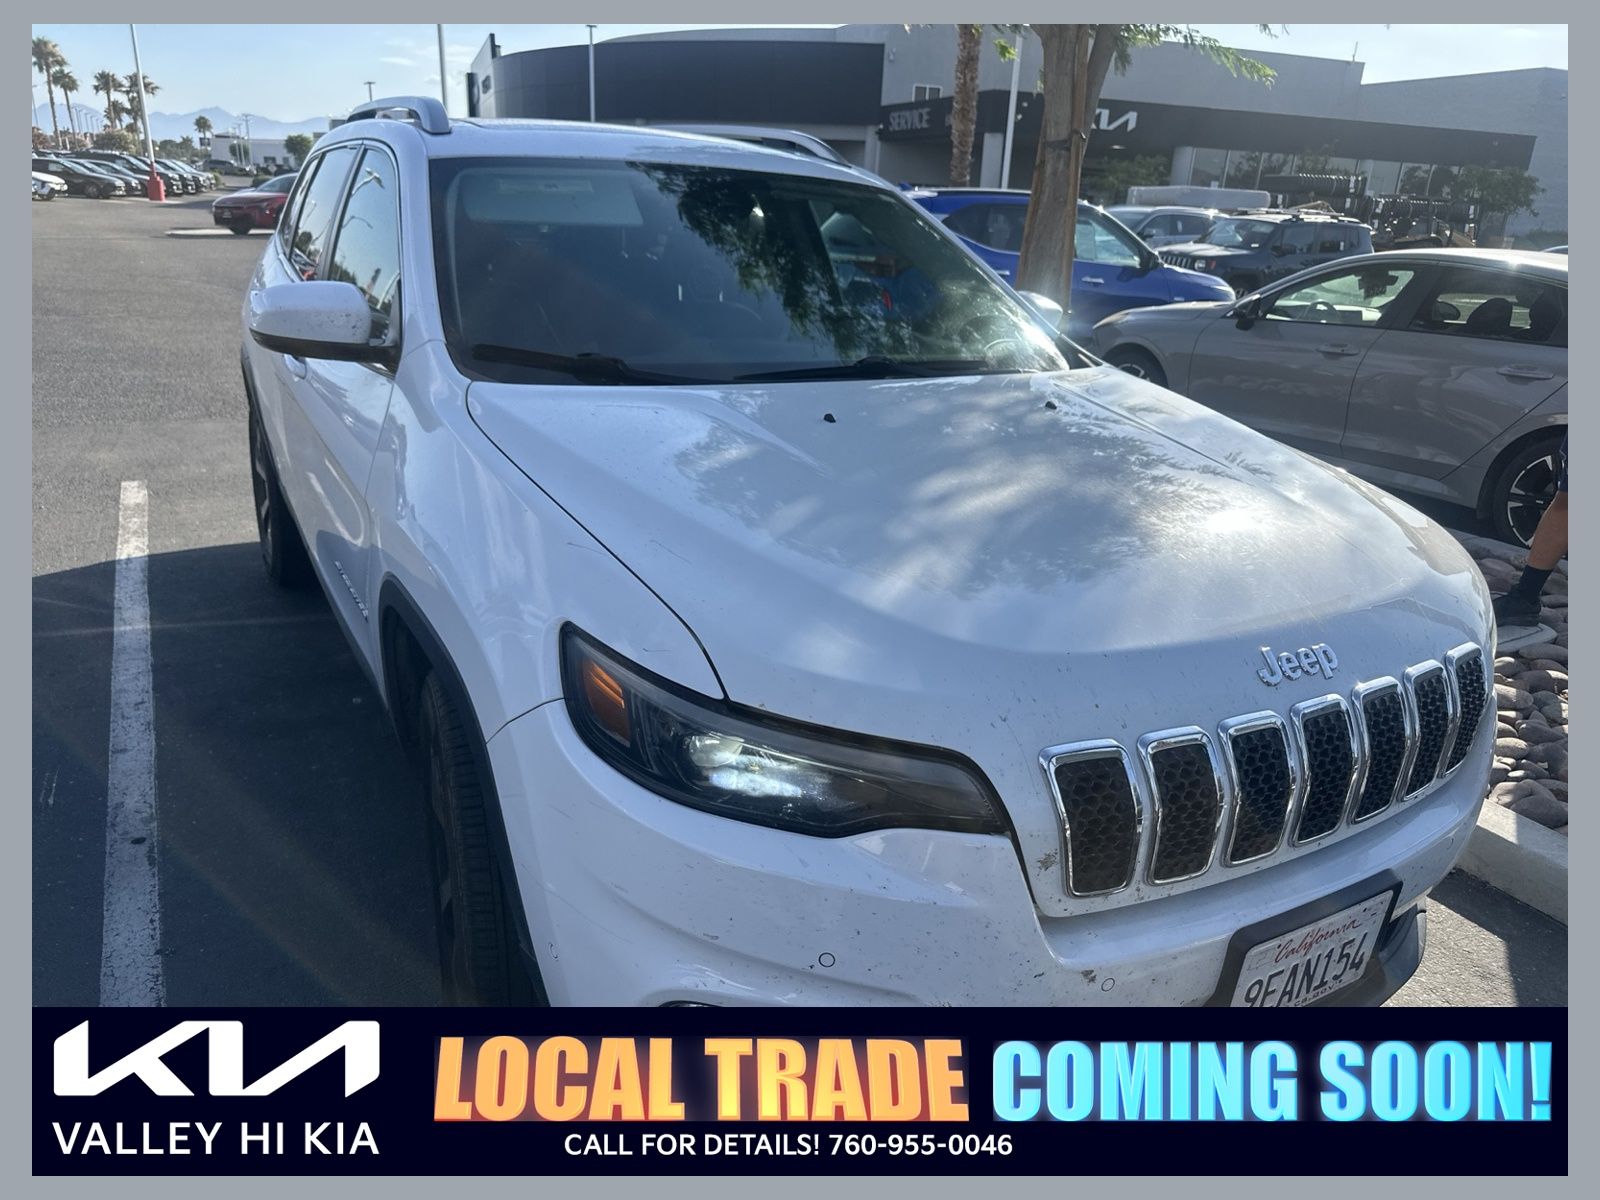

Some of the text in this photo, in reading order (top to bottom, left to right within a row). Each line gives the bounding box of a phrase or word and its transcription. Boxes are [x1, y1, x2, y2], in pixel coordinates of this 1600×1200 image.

[889, 108, 931, 132] SERVICE
[1256, 642, 1338, 687] Jeep
[1275, 917, 1362, 963] California
